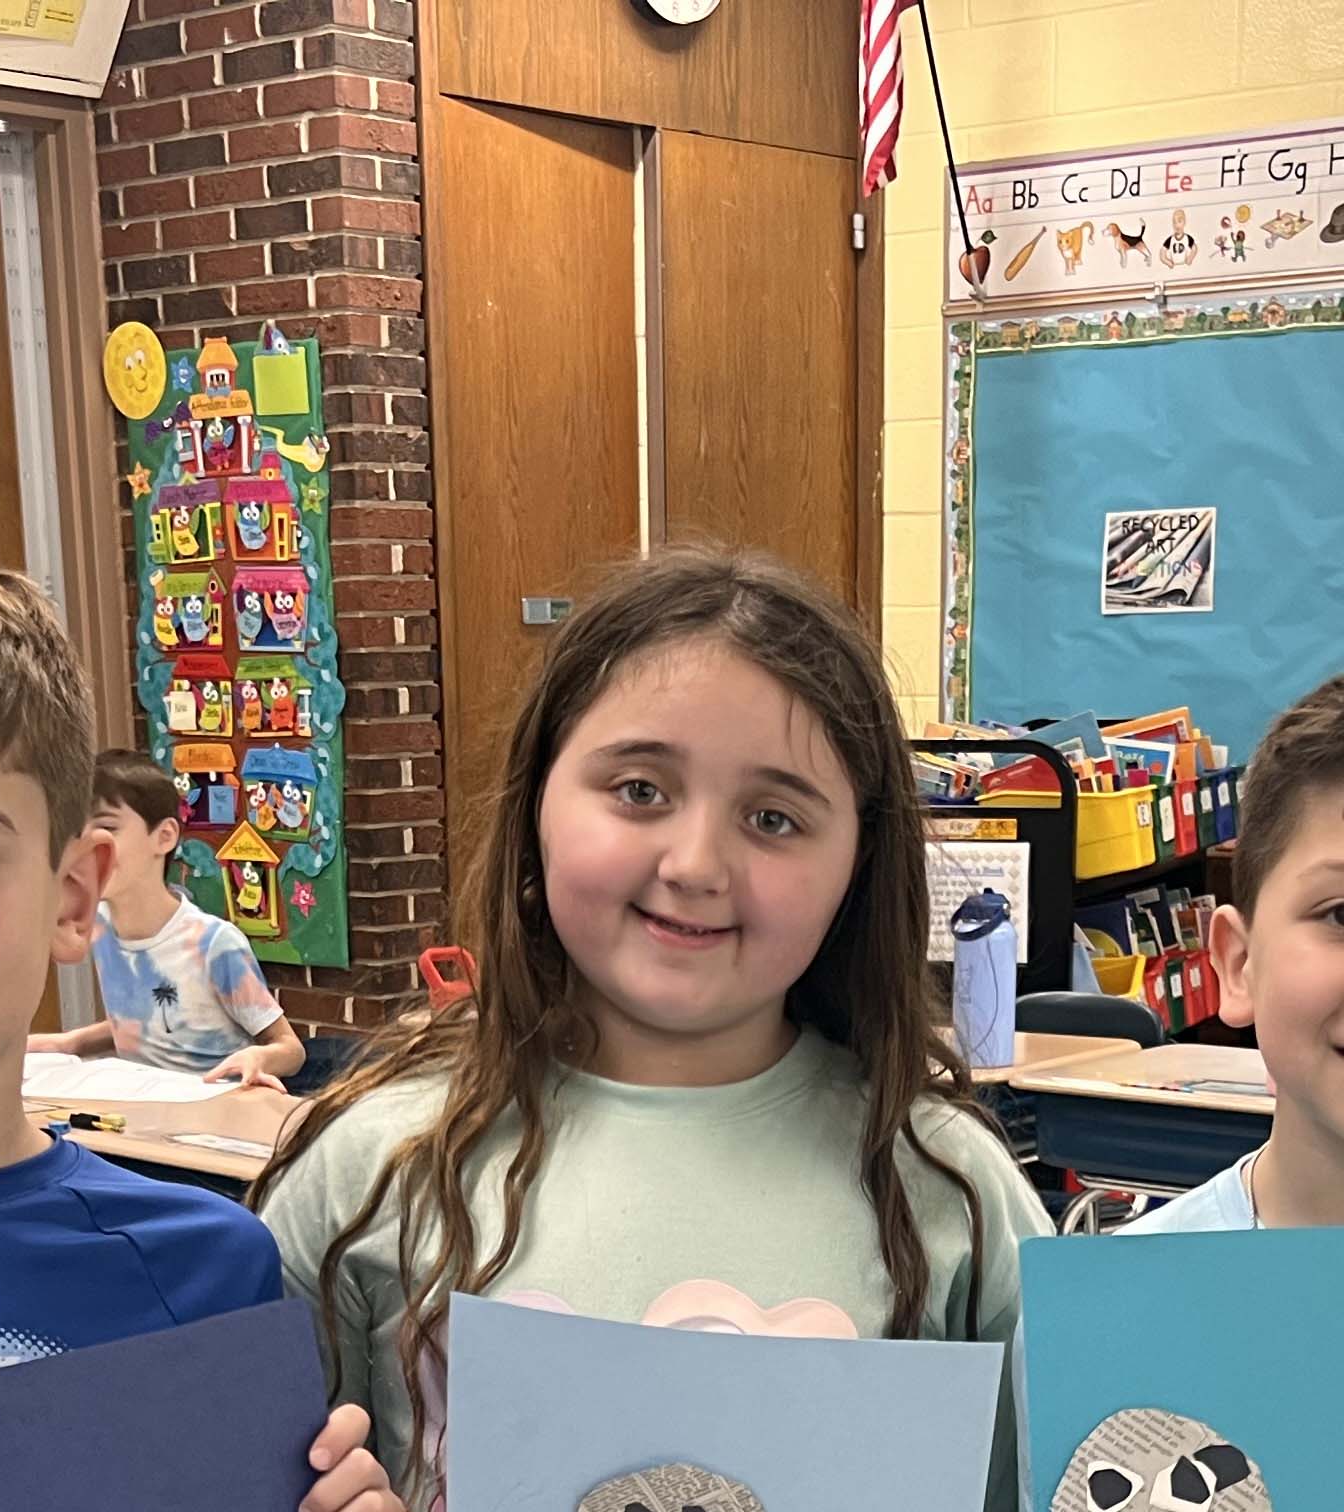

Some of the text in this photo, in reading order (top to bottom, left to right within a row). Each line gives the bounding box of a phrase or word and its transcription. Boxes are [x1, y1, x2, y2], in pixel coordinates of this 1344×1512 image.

[965, 185, 993, 215] Aa
[1012, 179, 1040, 210] Bb
[1061, 174, 1089, 203] Cc
[1111, 166, 1141, 199] Dd
[1165, 161, 1193, 193] Ee
[1221, 154, 1249, 188] Ff
[1268, 148, 1308, 194] Gg
[1121, 514, 1201, 536] RECYCLED
[1146, 537, 1176, 554] ART
